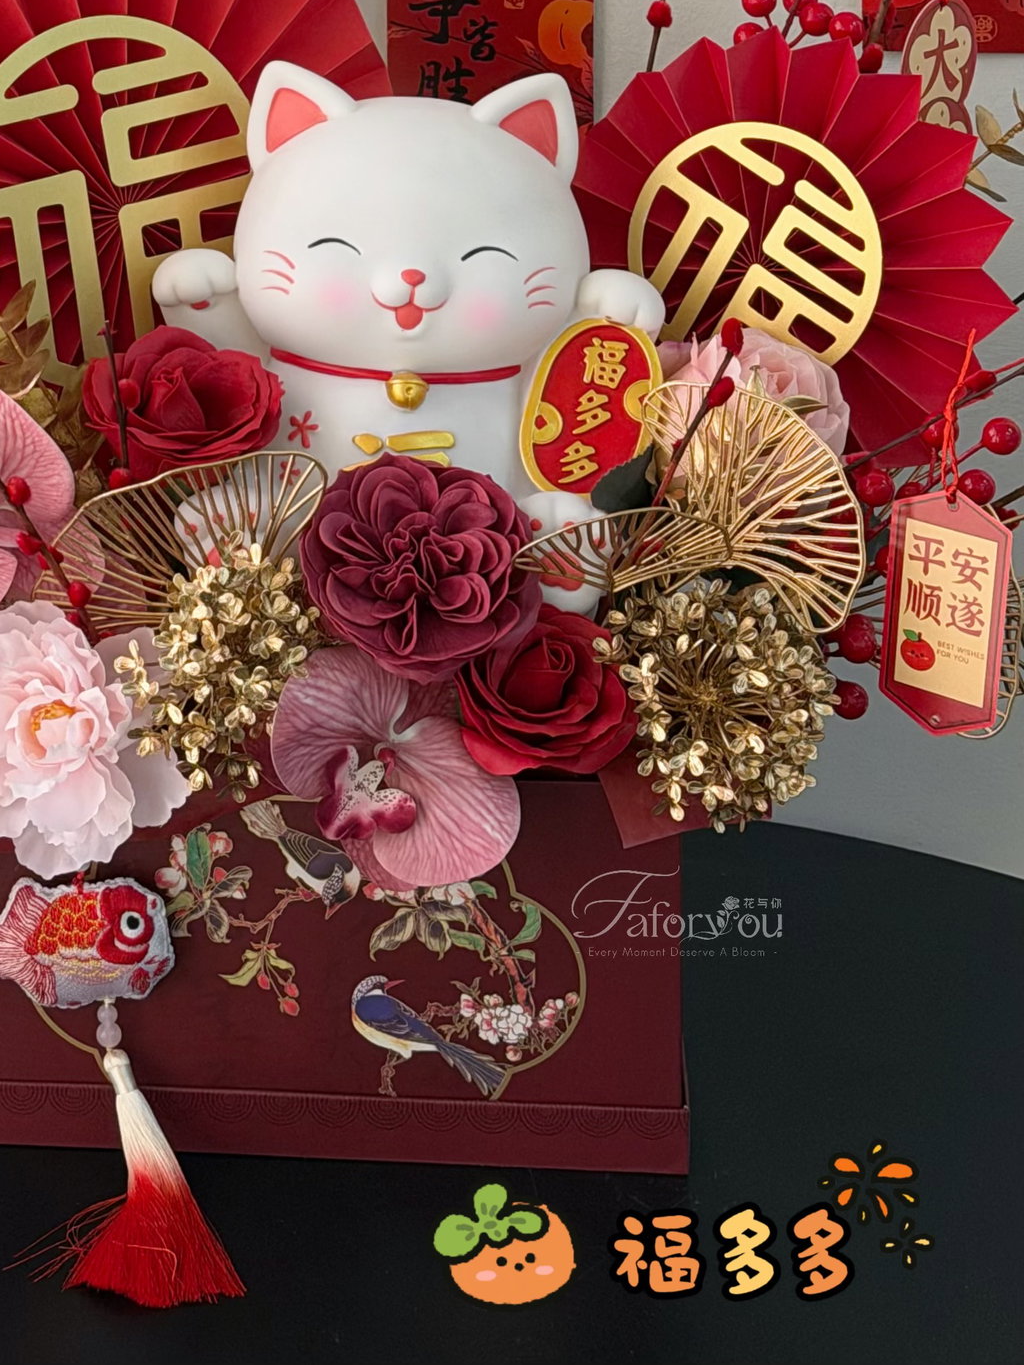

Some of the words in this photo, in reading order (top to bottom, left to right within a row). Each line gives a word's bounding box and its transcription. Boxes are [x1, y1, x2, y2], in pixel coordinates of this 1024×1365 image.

[923, 28, 961, 93] 大
[628, 121, 883, 366] 福
[559, 337, 631, 485] 福多多
[908, 533, 990, 592] 平安
[904, 578, 986, 638] 顺遂
[936, 648, 952, 660] FOR
[953, 654, 970, 666] YOU
[937, 640, 956, 653] BEST
[956, 645, 986, 661] WISHES
